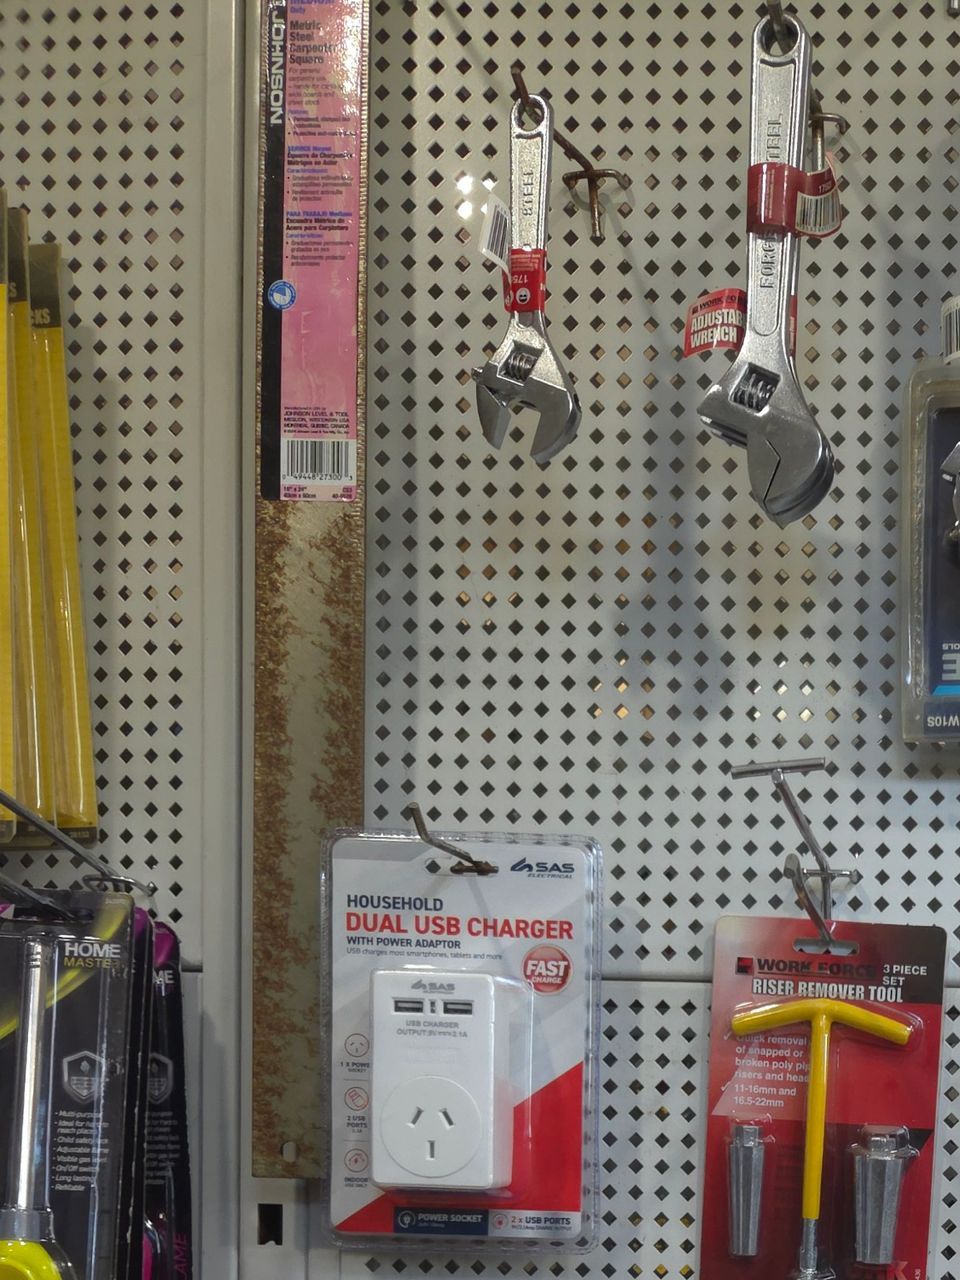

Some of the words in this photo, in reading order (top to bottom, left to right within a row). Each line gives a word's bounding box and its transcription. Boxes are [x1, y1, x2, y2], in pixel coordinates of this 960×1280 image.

[289, 21, 321, 31] Metric
[289, 55, 324, 65] Square
[270, 11, 286, 125] JOHNSON
[691, 325, 738, 349] WRENCH
[346, 894, 444, 912] HOUSEHOLD
[346, 912, 408, 935] DUAL
[414, 915, 461, 937] USB
[466, 917, 574, 941] CHARGER
[346, 936, 374, 947] WITH
[376, 937, 413, 948] POWER
[415, 938, 461, 950] ADAPTOR
[64, 942, 121, 958] HOME
[526, 959, 568, 978] FAST
[757, 958, 813, 973] WORK
[883, 964, 890, 974] 3
[892, 965, 928, 976] PIECE
[531, 976, 562, 985] CHARGE
[882, 976, 906, 986] SET
[752, 978, 794, 996] RISER
[798, 981, 865, 1000] REMOVER
[868, 985, 903, 1003] TOOL
[767, 1035, 808, 1046] removal
[735, 1046, 747, 1055] of
[748, 1048, 791, 1059] snapped
[793, 1050, 804, 1058] or
[735, 1058, 770, 1068] broken
[771, 1060, 793, 1072] poly
[735, 1070, 762, 1080] risers
[765, 1071, 783, 1081] and
[734, 1085, 776, 1096] 11-16mm
[778, 1087, 797, 1097] and
[417, 1213, 449, 1222] POWER
[450, 1214, 483, 1223] SOCKET
